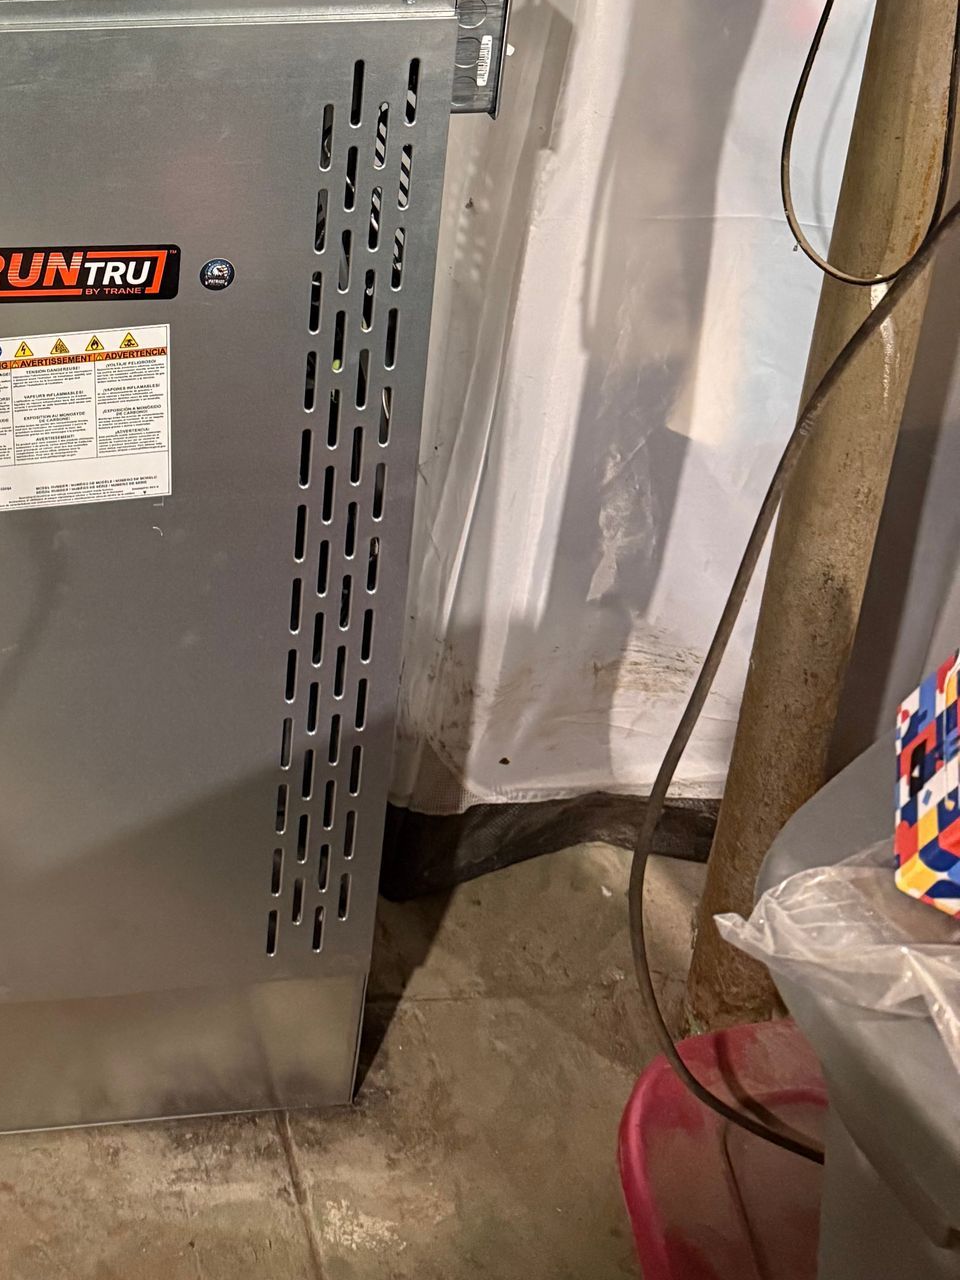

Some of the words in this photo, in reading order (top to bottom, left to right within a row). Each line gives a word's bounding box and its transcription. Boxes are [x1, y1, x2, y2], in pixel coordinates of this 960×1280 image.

[103, 287, 142, 295] TRANE
[21, 355, 92, 368] AVERTISSEMENT
[105, 348, 166, 360] ADVERTENCIA
